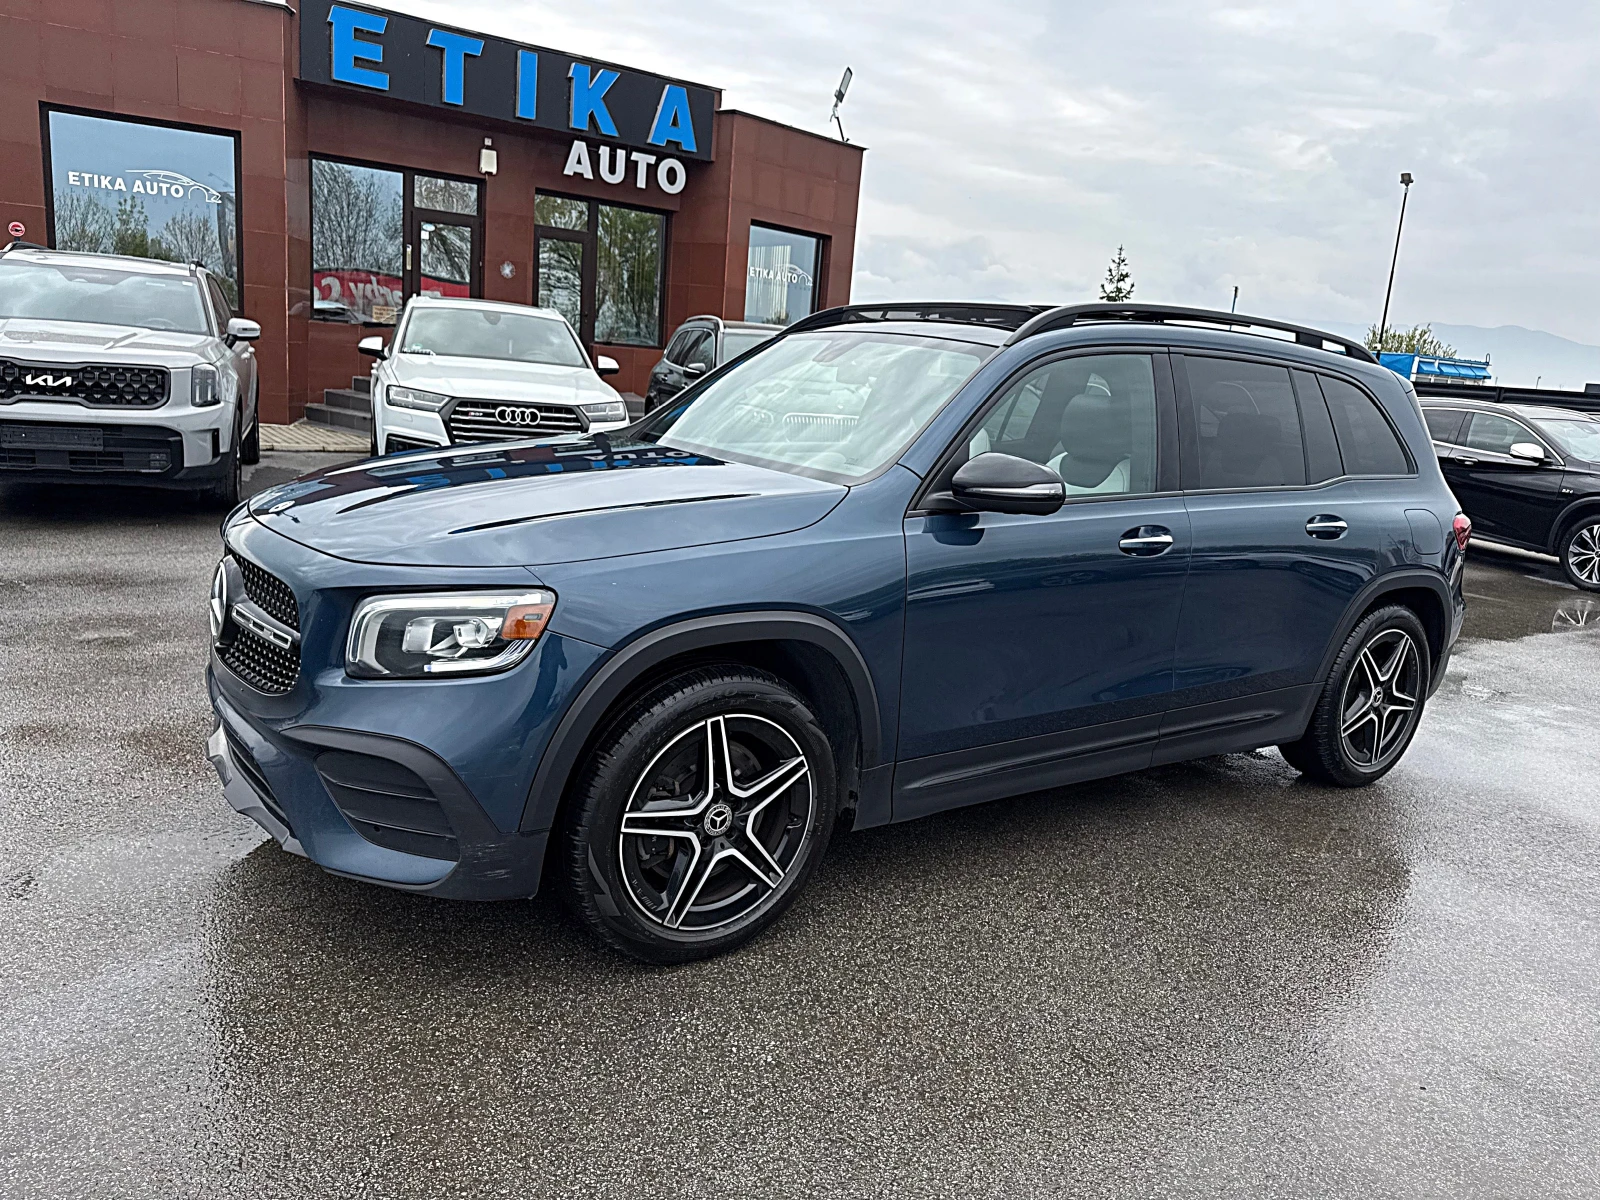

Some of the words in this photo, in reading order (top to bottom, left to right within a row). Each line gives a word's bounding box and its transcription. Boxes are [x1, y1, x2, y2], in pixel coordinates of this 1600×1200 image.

[328, 4, 698, 153] ETIKA
[67, 170, 127, 192] ETIKA
[132, 179, 185, 199] AUTO
[563, 140, 687, 195] AUTO
[749, 266, 774, 280] ETIKA
[775, 271, 798, 284] AUTO
